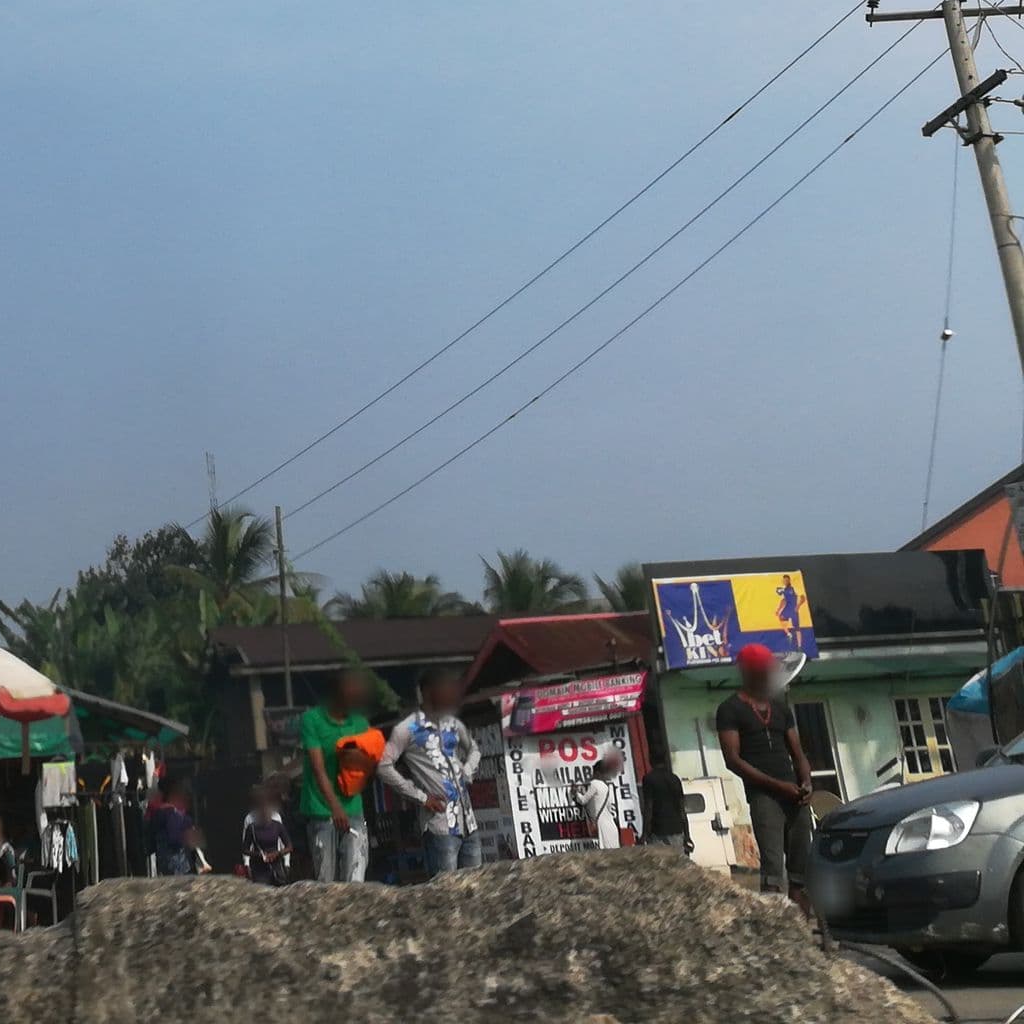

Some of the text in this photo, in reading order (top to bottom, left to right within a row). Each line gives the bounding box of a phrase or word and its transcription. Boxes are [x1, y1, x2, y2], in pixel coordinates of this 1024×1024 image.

[687, 629, 723, 648] bet
[686, 645, 729, 660] KING
[605, 674, 642, 687] BANKING
[539, 737, 598, 762] POS
[610, 726, 632, 800] MOLE
[520, 822, 537, 858] BAN
[583, 838, 600, 850] MON
